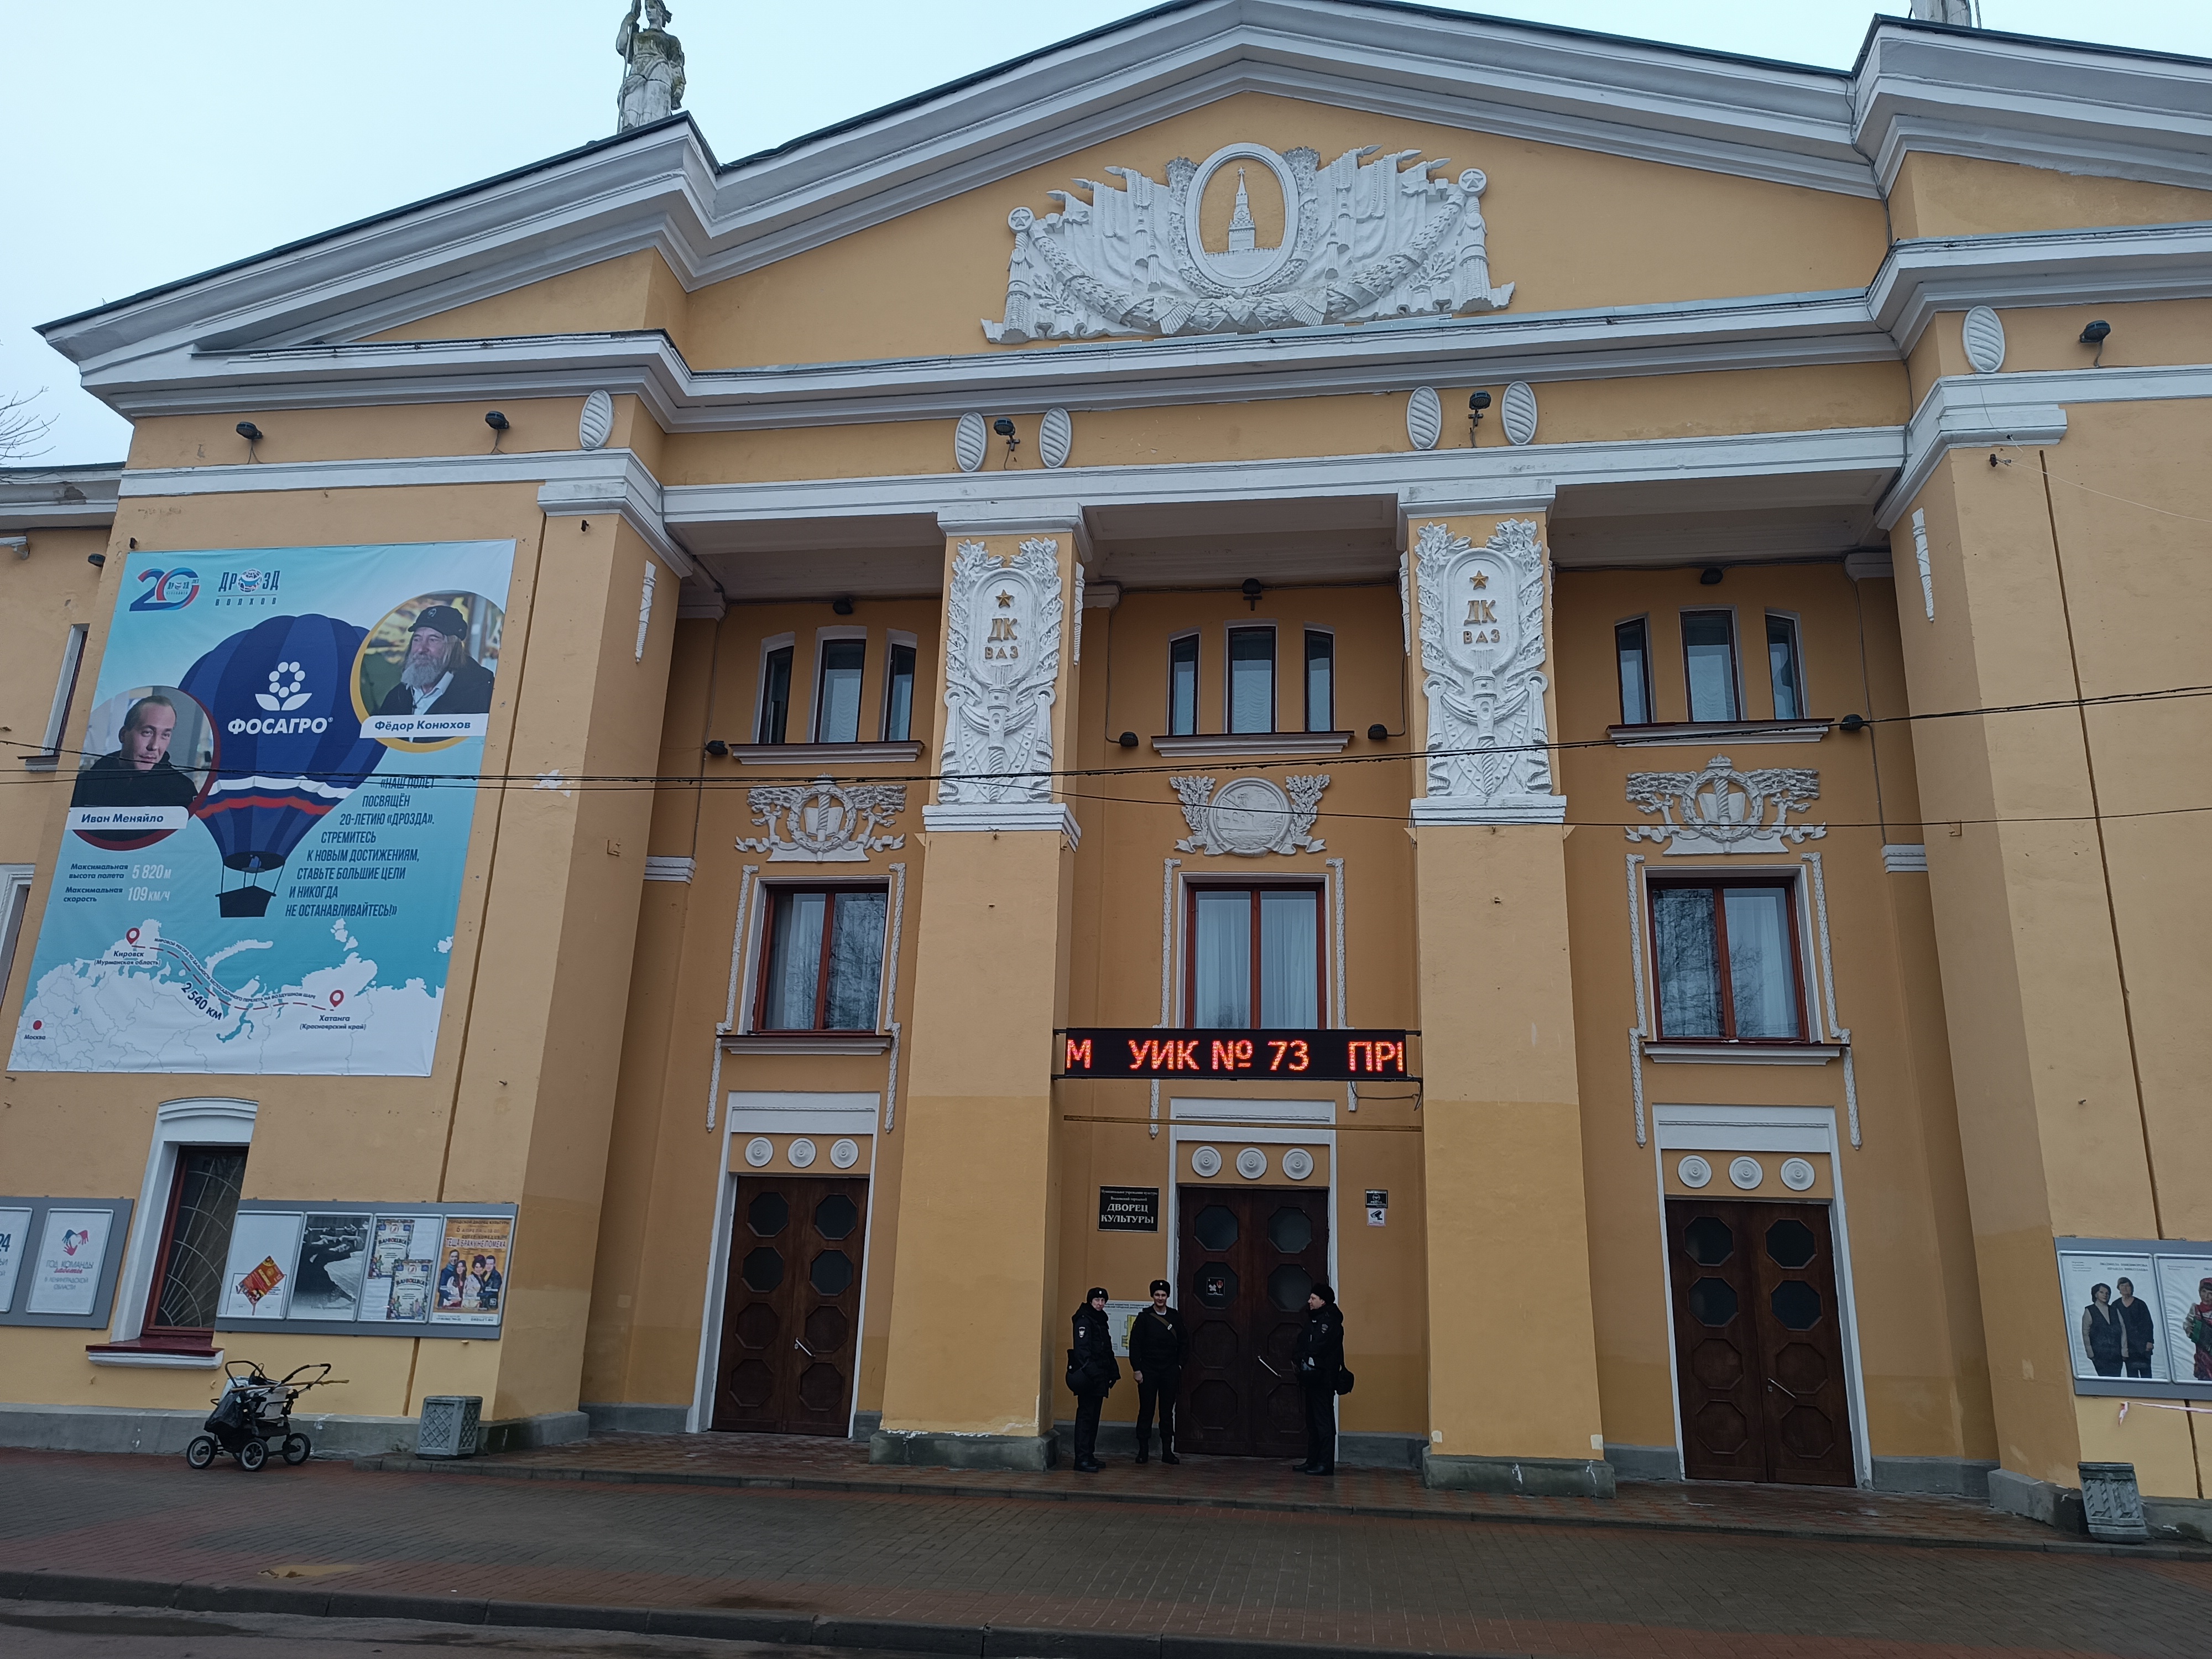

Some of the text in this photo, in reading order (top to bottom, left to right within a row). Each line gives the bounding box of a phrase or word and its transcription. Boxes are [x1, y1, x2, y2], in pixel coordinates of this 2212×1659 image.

[1464, 599, 1498, 626] ДК
[987, 618, 1018, 643] ДК
[1463, 629, 1500, 644] ВАЗ
[984, 646, 1019, 659] ВАЗ
[227, 717, 327, 735] ФОСАГРО
[374, 719, 471, 732] Фёдор Конюхов
[362, 793, 410, 807] ПОСВЯЩЁН
[81, 813, 164, 823] Иван Меняйло
[339, 813, 435, 826] 20-ЛЕТИЮ «ДРОЗДА».
[321, 831, 377, 843] СТРЕМИТЕСЬ
[306, 849, 420, 862] К НОВЫМ ДОСТИЖЕНИЯМ,
[132, 865, 140, 879] 5
[142, 864, 164, 879] 820
[297, 867, 406, 880] СТАВЬТЕ БОЛЬШИЕ ЦЕЛИ
[128, 886, 148, 901] 109
[289, 886, 338, 899] И НИКОГДА
[285, 902, 398, 916] НЕ ОСТАНАВЛИВАЙТЕСЬ!»
[181, 982, 191, 993] 2
[187, 992, 208, 1010] 540
[1128, 1040, 1200, 1070] УИК
[1212, 1040, 1253, 1070] №
[1267, 1040, 1310, 1071] 73
[1107, 1203, 1148, 1213] ДВОРЕЦ
[1101, 1214, 1154, 1224] КУЛЬТУРЫ
